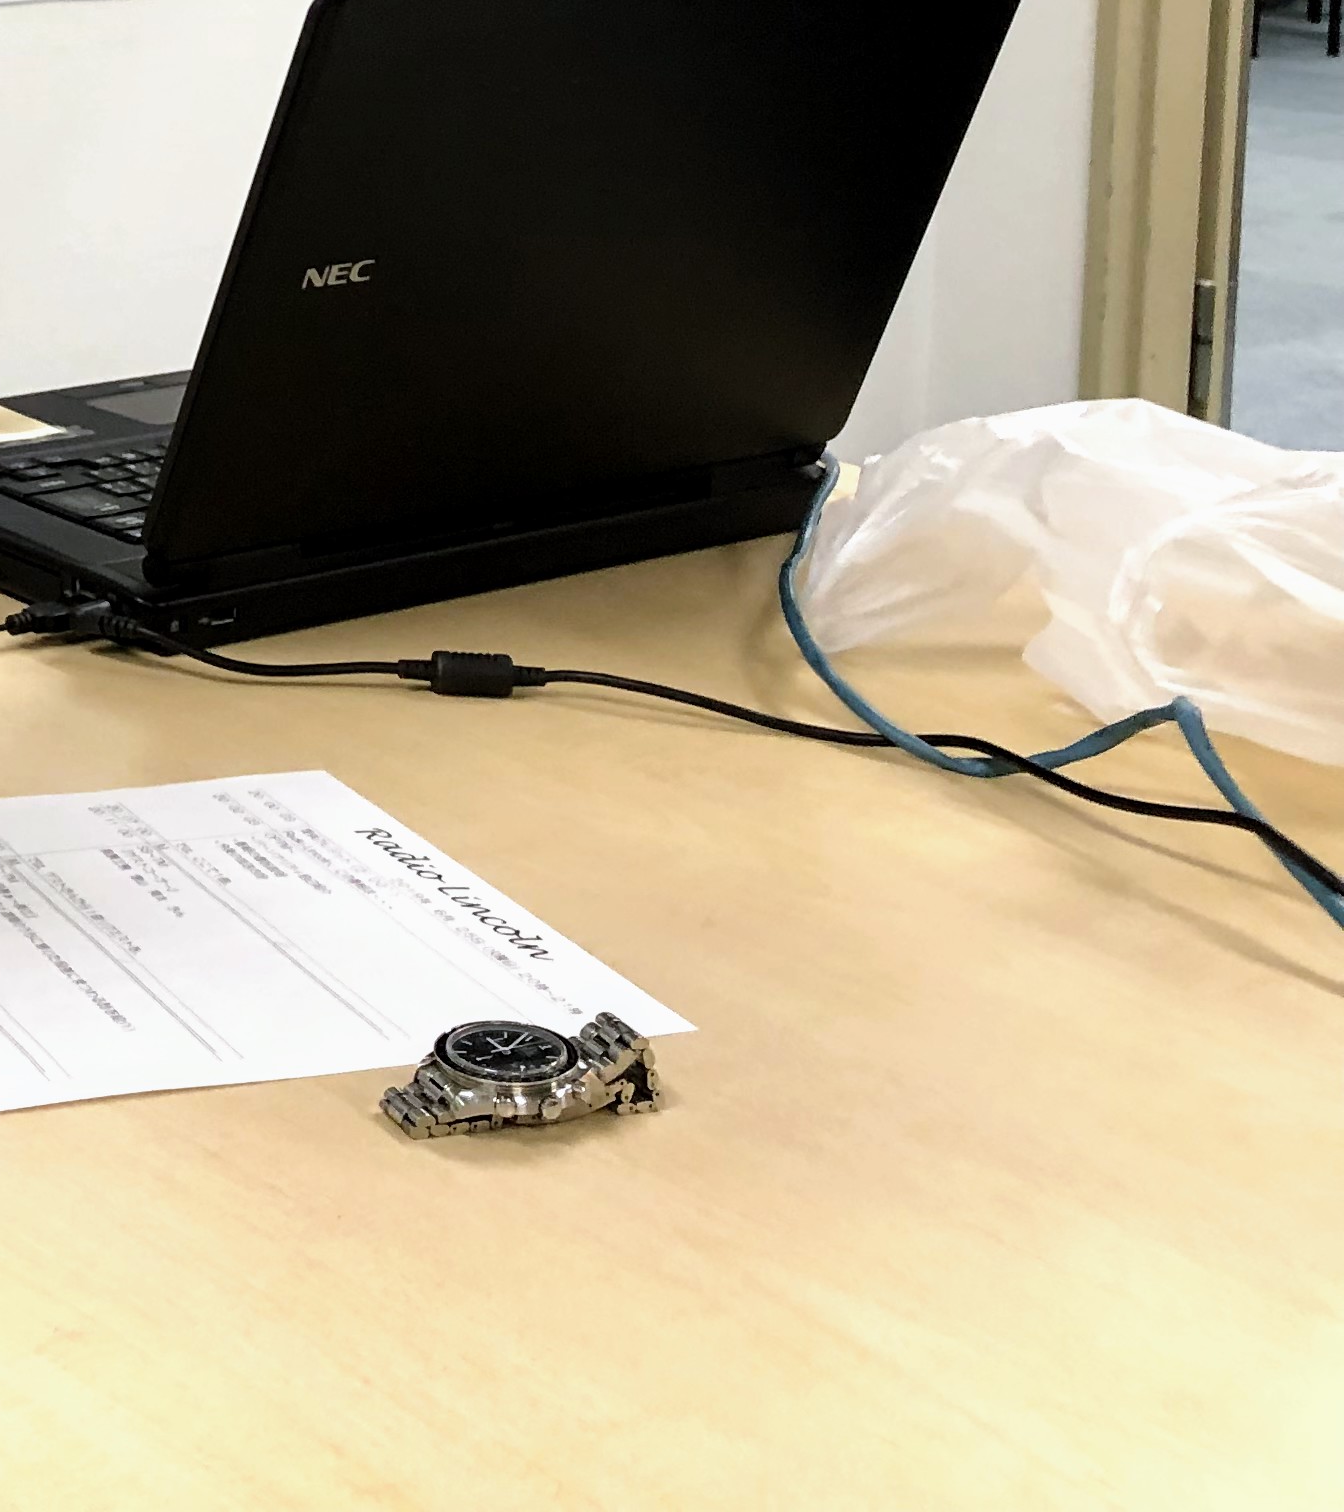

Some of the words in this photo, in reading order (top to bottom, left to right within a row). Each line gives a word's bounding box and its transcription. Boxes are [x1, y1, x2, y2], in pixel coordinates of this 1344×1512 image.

[302, 258, 375, 289] NEC
[354, 826, 446, 883] Radio
[438, 885, 554, 962] Lincoln
